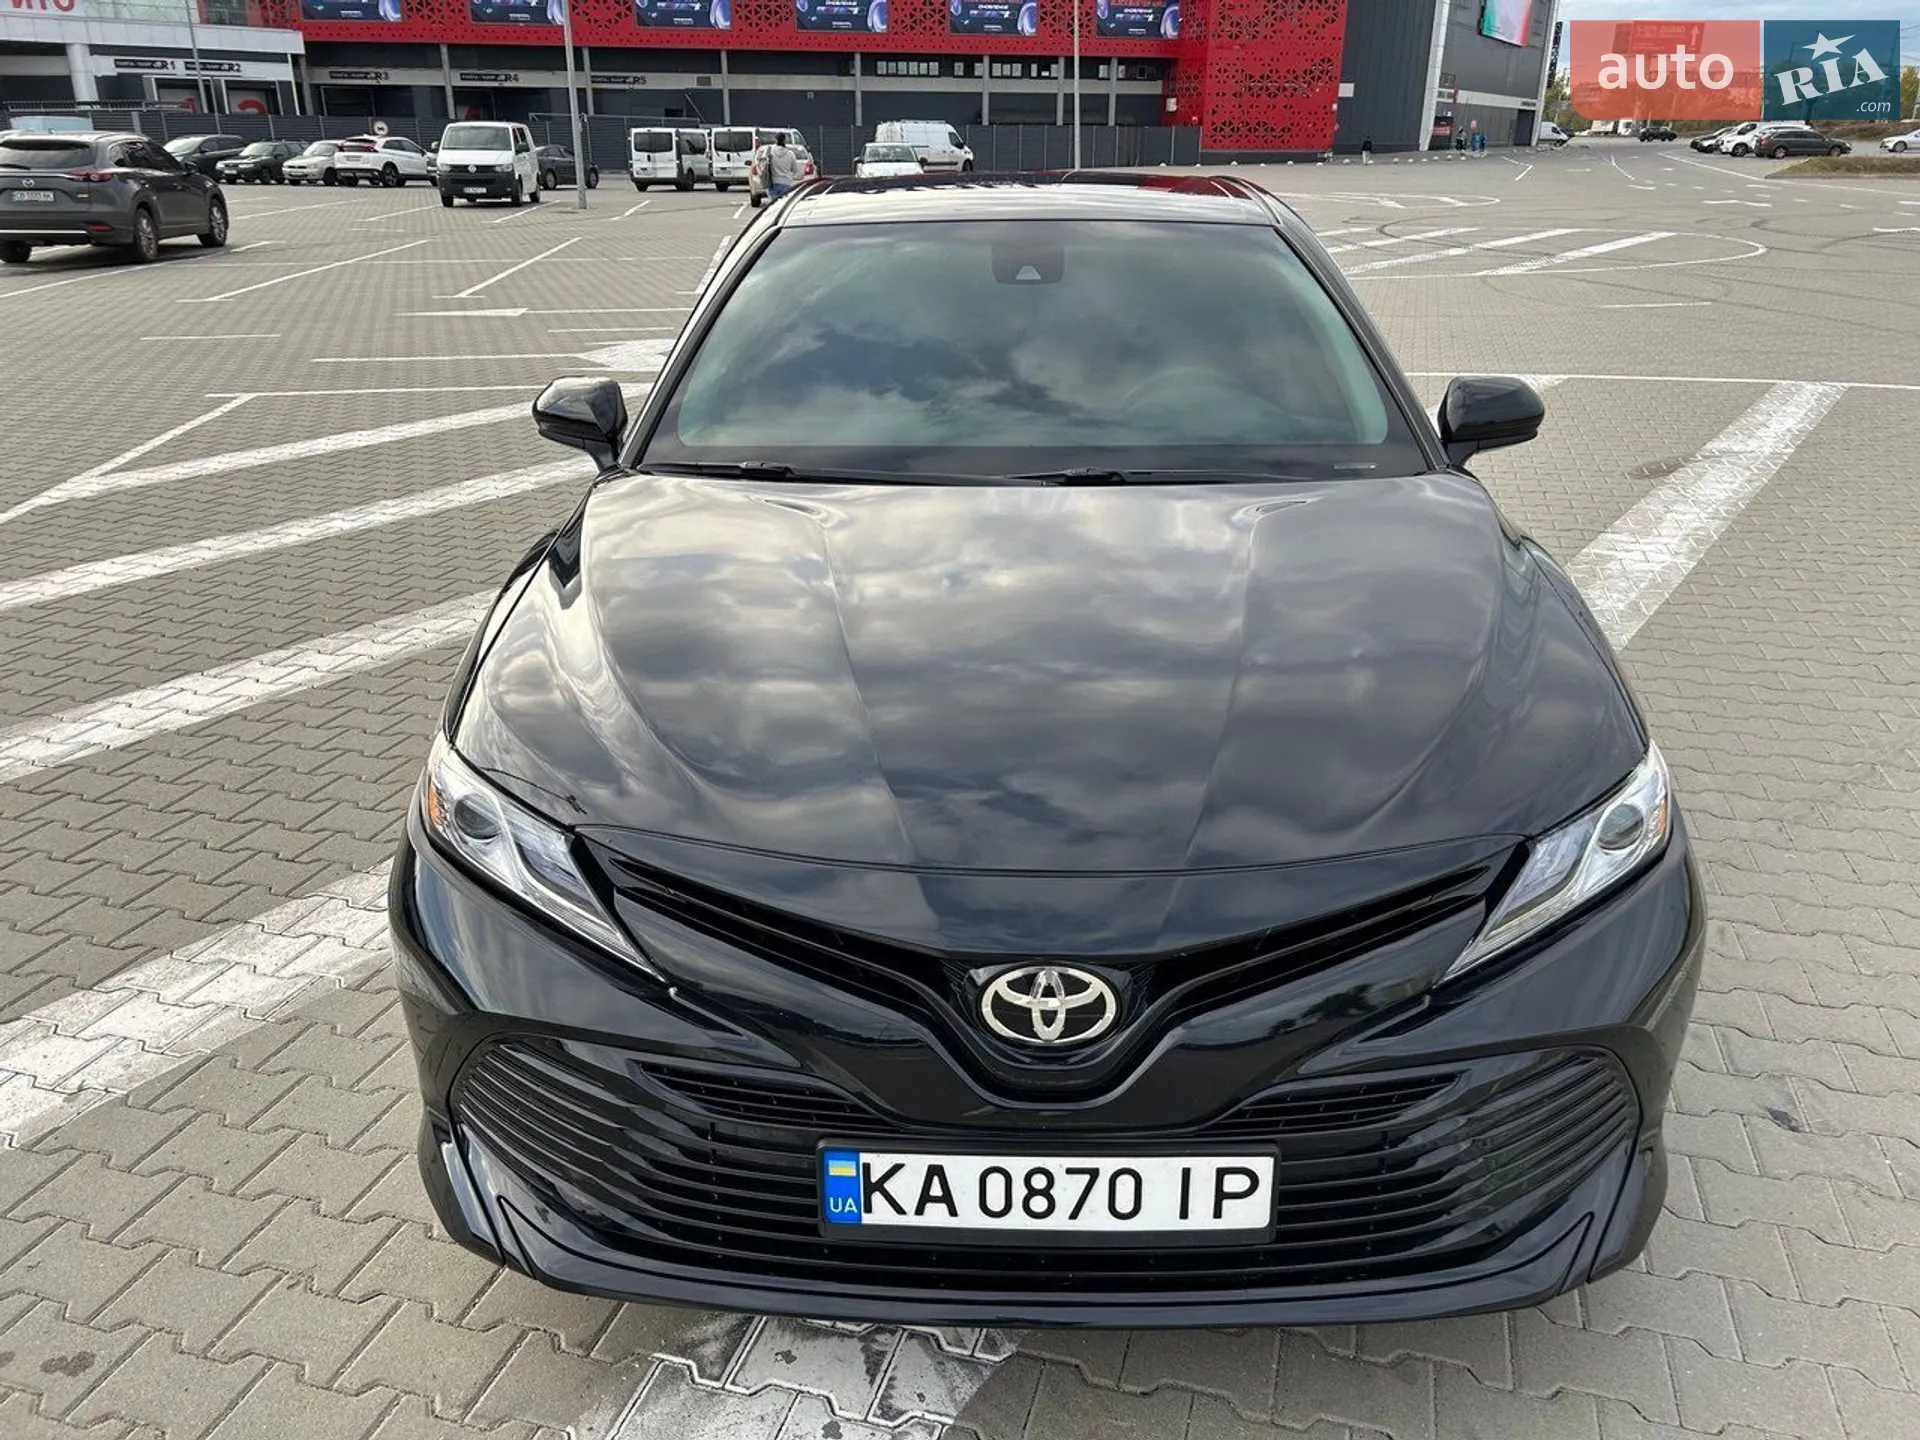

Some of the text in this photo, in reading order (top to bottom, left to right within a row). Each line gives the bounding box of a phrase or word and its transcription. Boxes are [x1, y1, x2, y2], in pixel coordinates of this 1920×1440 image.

[829, 1196, 858, 1213] UA
[862, 1162, 1260, 1220] KA 0870 IP
